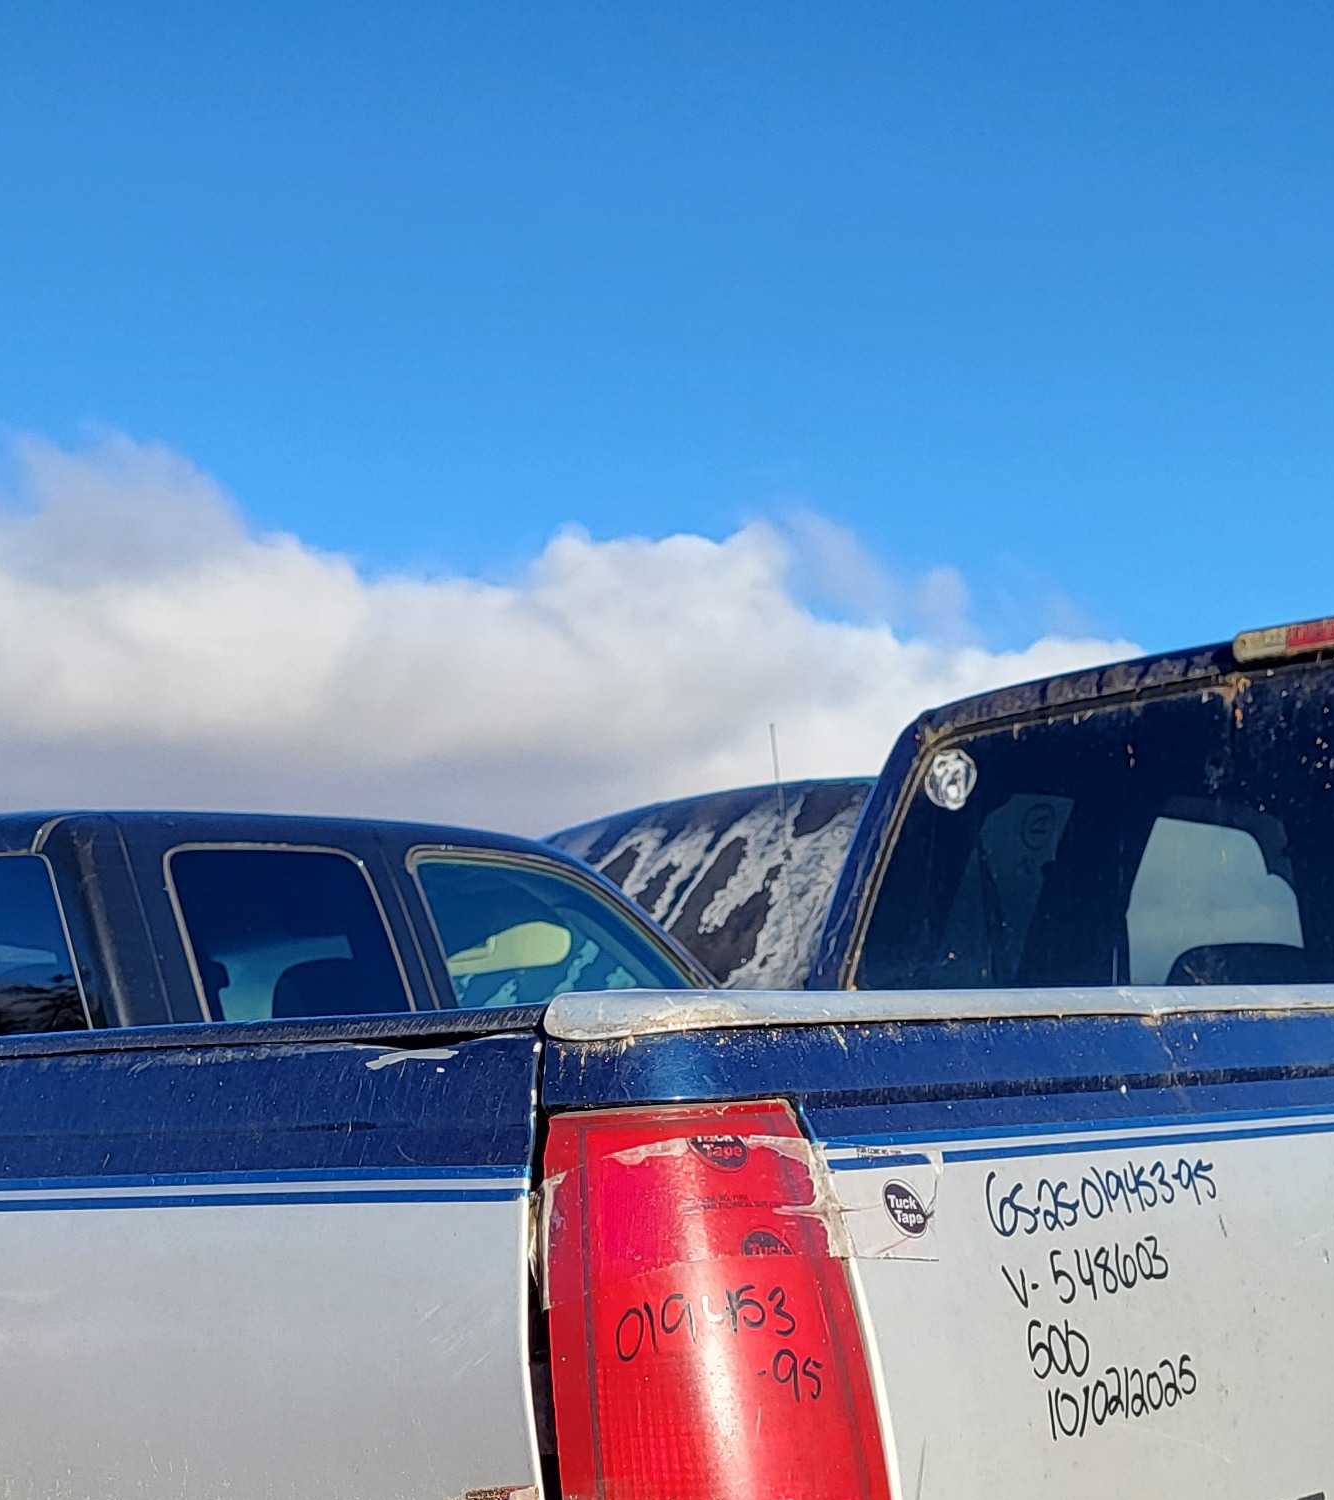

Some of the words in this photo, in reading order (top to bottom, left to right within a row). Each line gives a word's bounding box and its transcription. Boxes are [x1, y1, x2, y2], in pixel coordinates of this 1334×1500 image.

[887, 1194, 917, 1209] Tuck
[894, 1209, 925, 1227] Tape
[1049, 1235, 1169, 1304] 548603
